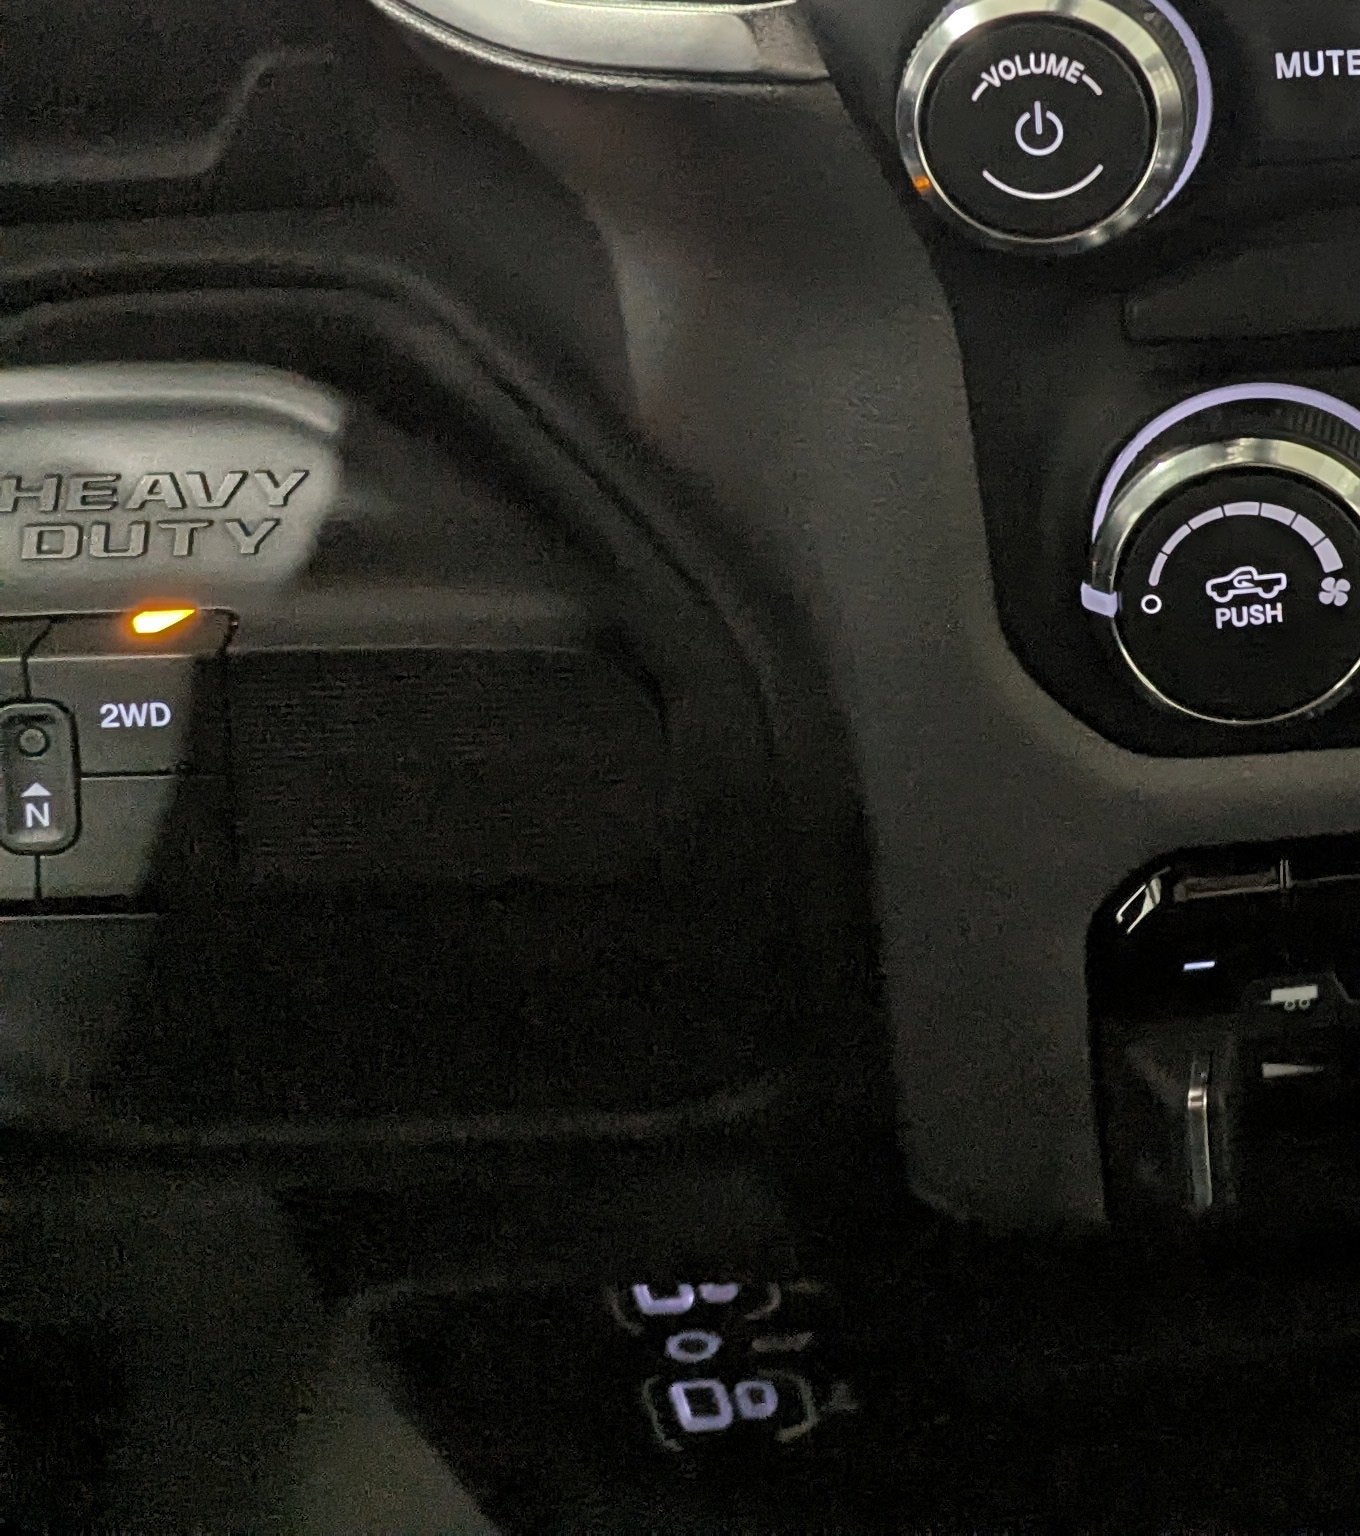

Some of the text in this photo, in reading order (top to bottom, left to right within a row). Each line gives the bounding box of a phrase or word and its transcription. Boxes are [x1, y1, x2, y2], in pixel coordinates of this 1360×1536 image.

[980, 52, 1085, 89] VOLUME
[0, 469, 309, 513] HEAVY
[20, 518, 281, 560] DUTY
[1215, 602, 1283, 629] PUSH
[100, 702, 172, 729] 2WD
[25, 803, 50, 829] N
